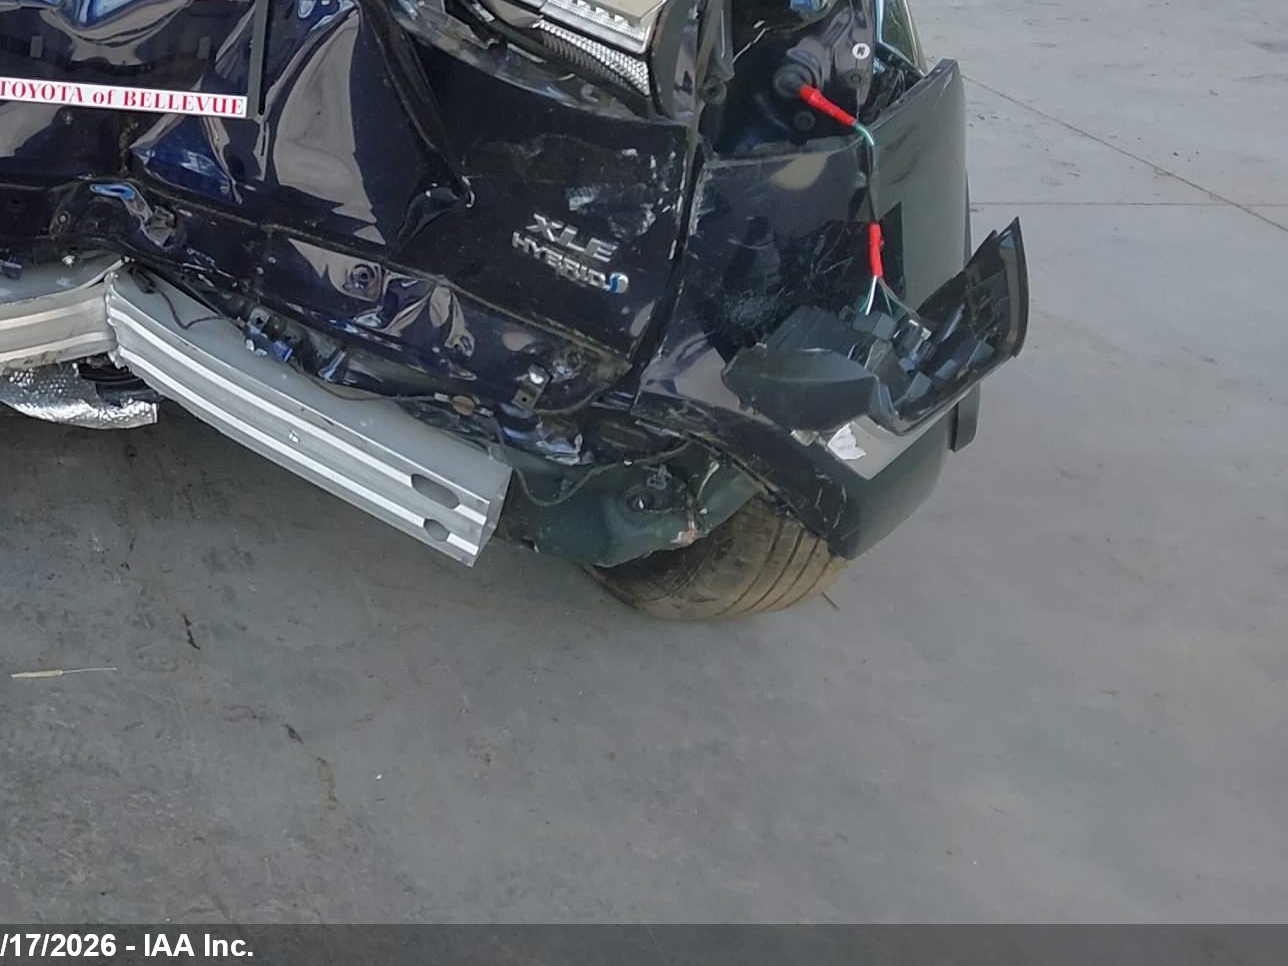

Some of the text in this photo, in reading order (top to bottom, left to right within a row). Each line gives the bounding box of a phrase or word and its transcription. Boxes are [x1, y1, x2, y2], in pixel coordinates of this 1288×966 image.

[92, 89, 114, 105] of
[123, 90, 245, 115] BELLEVUE
[512, 231, 609, 290] HYBRID
[526, 212, 619, 263] XLE
